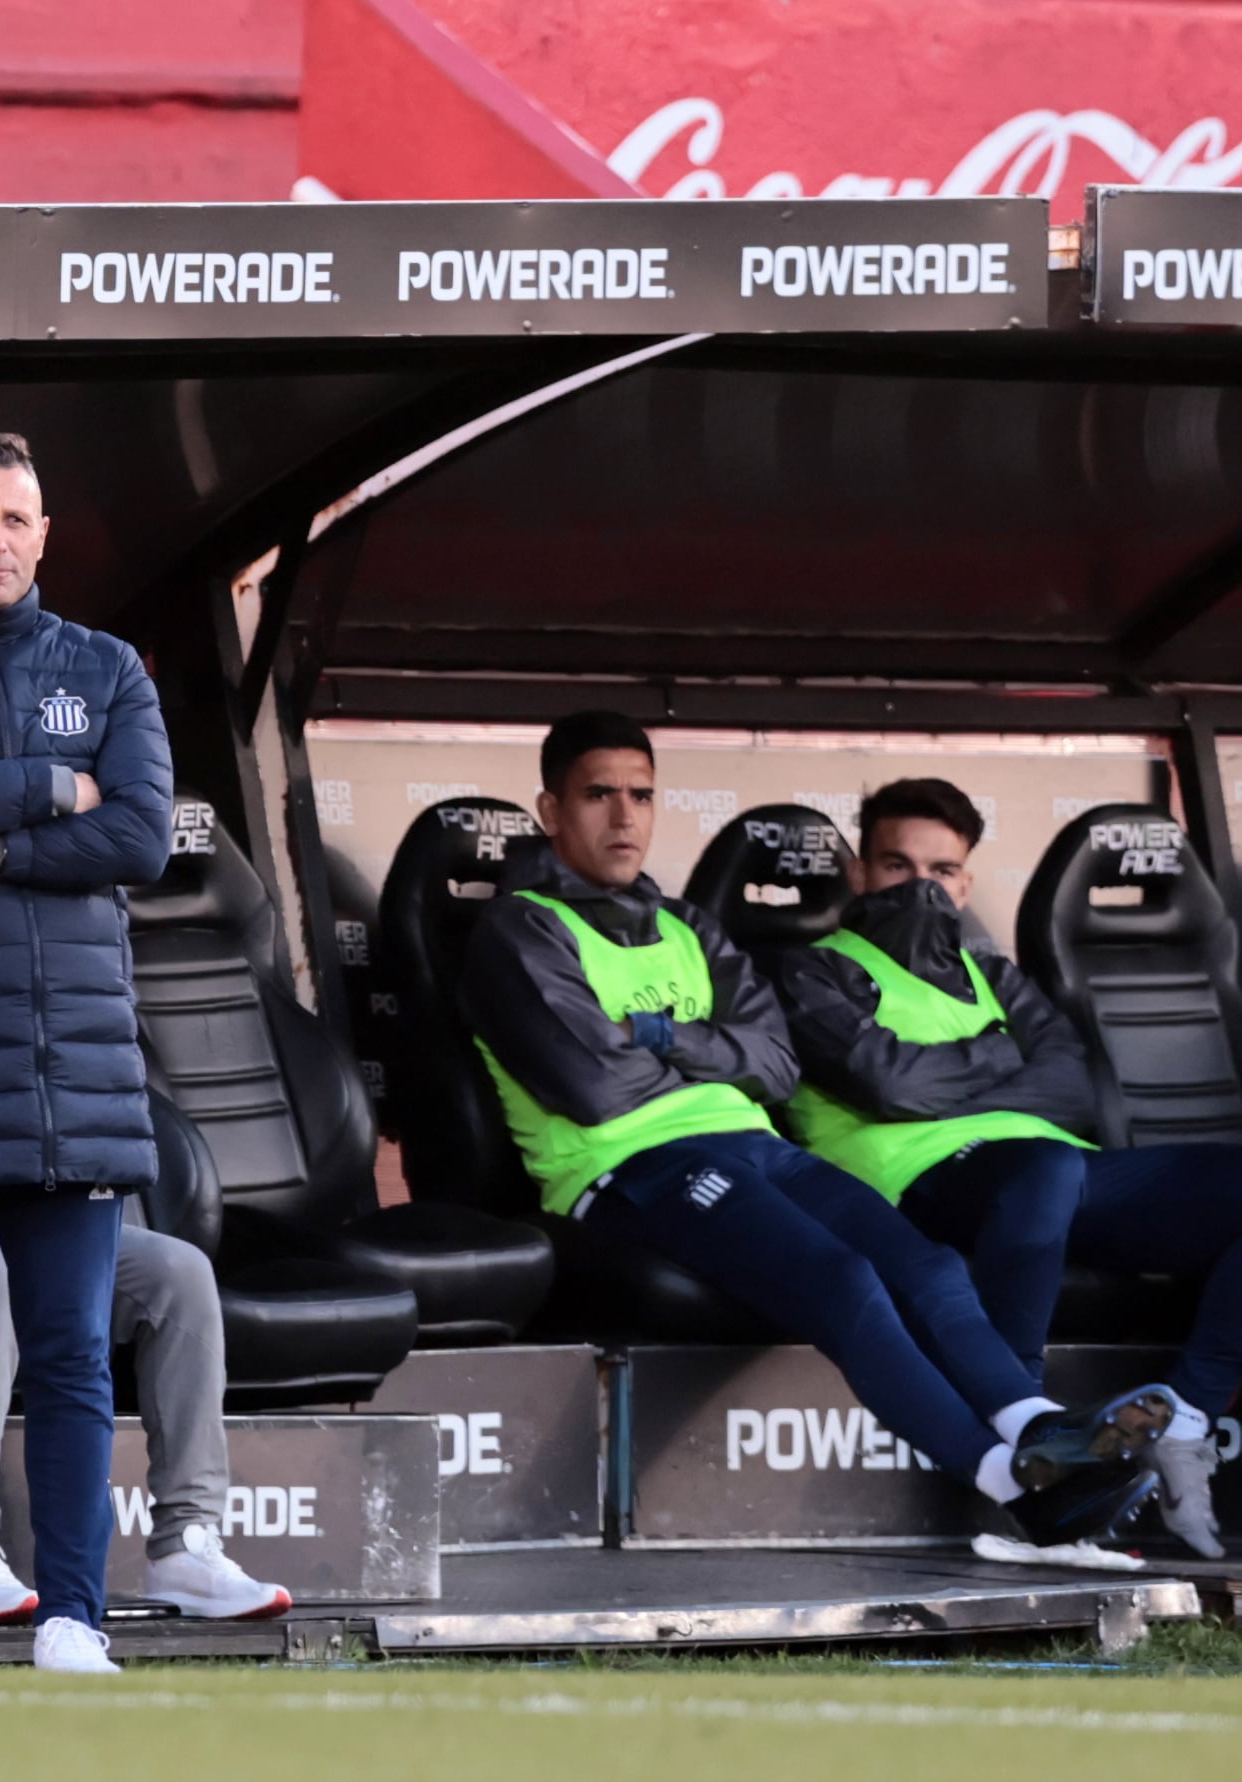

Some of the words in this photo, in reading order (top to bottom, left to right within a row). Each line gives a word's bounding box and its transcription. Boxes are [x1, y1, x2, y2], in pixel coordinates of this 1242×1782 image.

[61, 252, 333, 303] POWERADE
[398, 248, 668, 301] POWERADE
[741, 244, 1009, 297] POWERADE
[664, 790, 737, 811] POWER
[437, 808, 535, 835] POWER
[172, 829, 210, 855] DE
[744, 821, 839, 849] POWER
[1090, 823, 1184, 849] POWER
[776, 852, 834, 875] ADE
[1120, 850, 1176, 875] ADE
